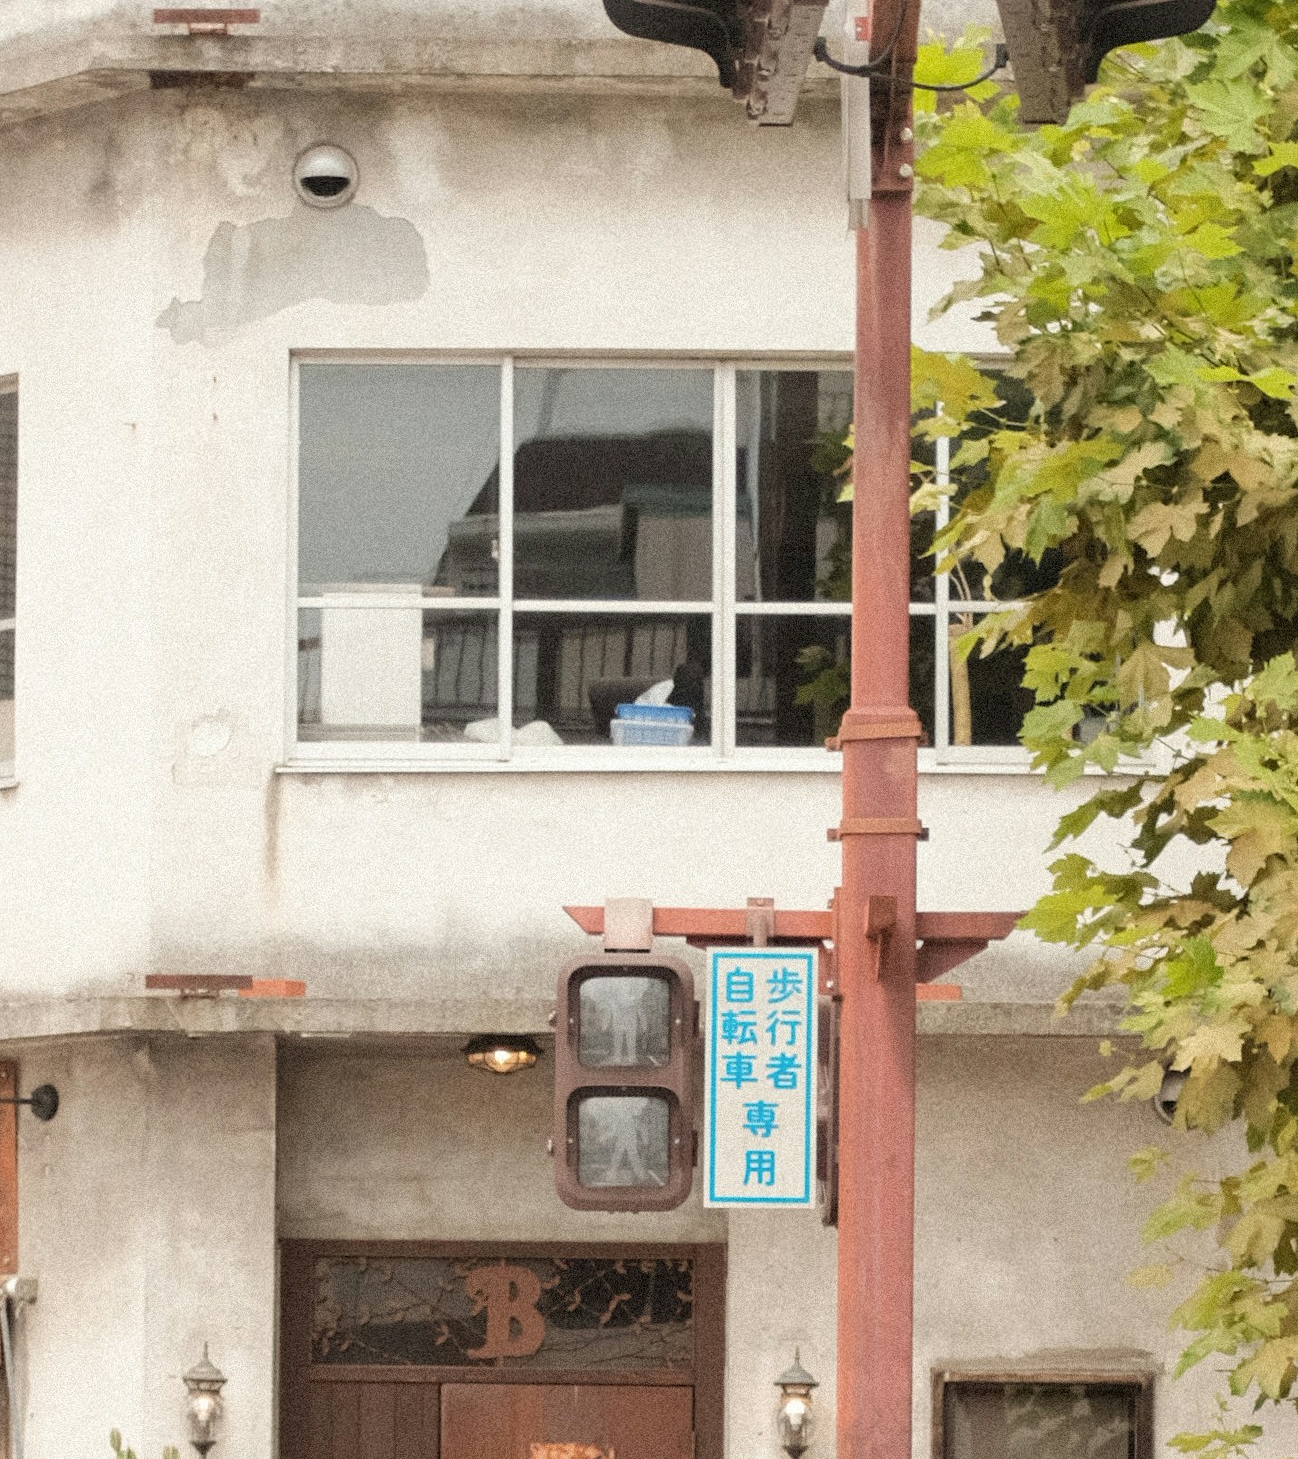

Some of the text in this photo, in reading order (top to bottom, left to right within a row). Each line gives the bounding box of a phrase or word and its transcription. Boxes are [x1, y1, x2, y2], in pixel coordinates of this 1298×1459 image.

[720, 967, 758, 1090] 自転車
[765, 967, 803, 1090] 歩行者
[742, 1100, 780, 1186] 専用
[465, 1263, 546, 1359] B
